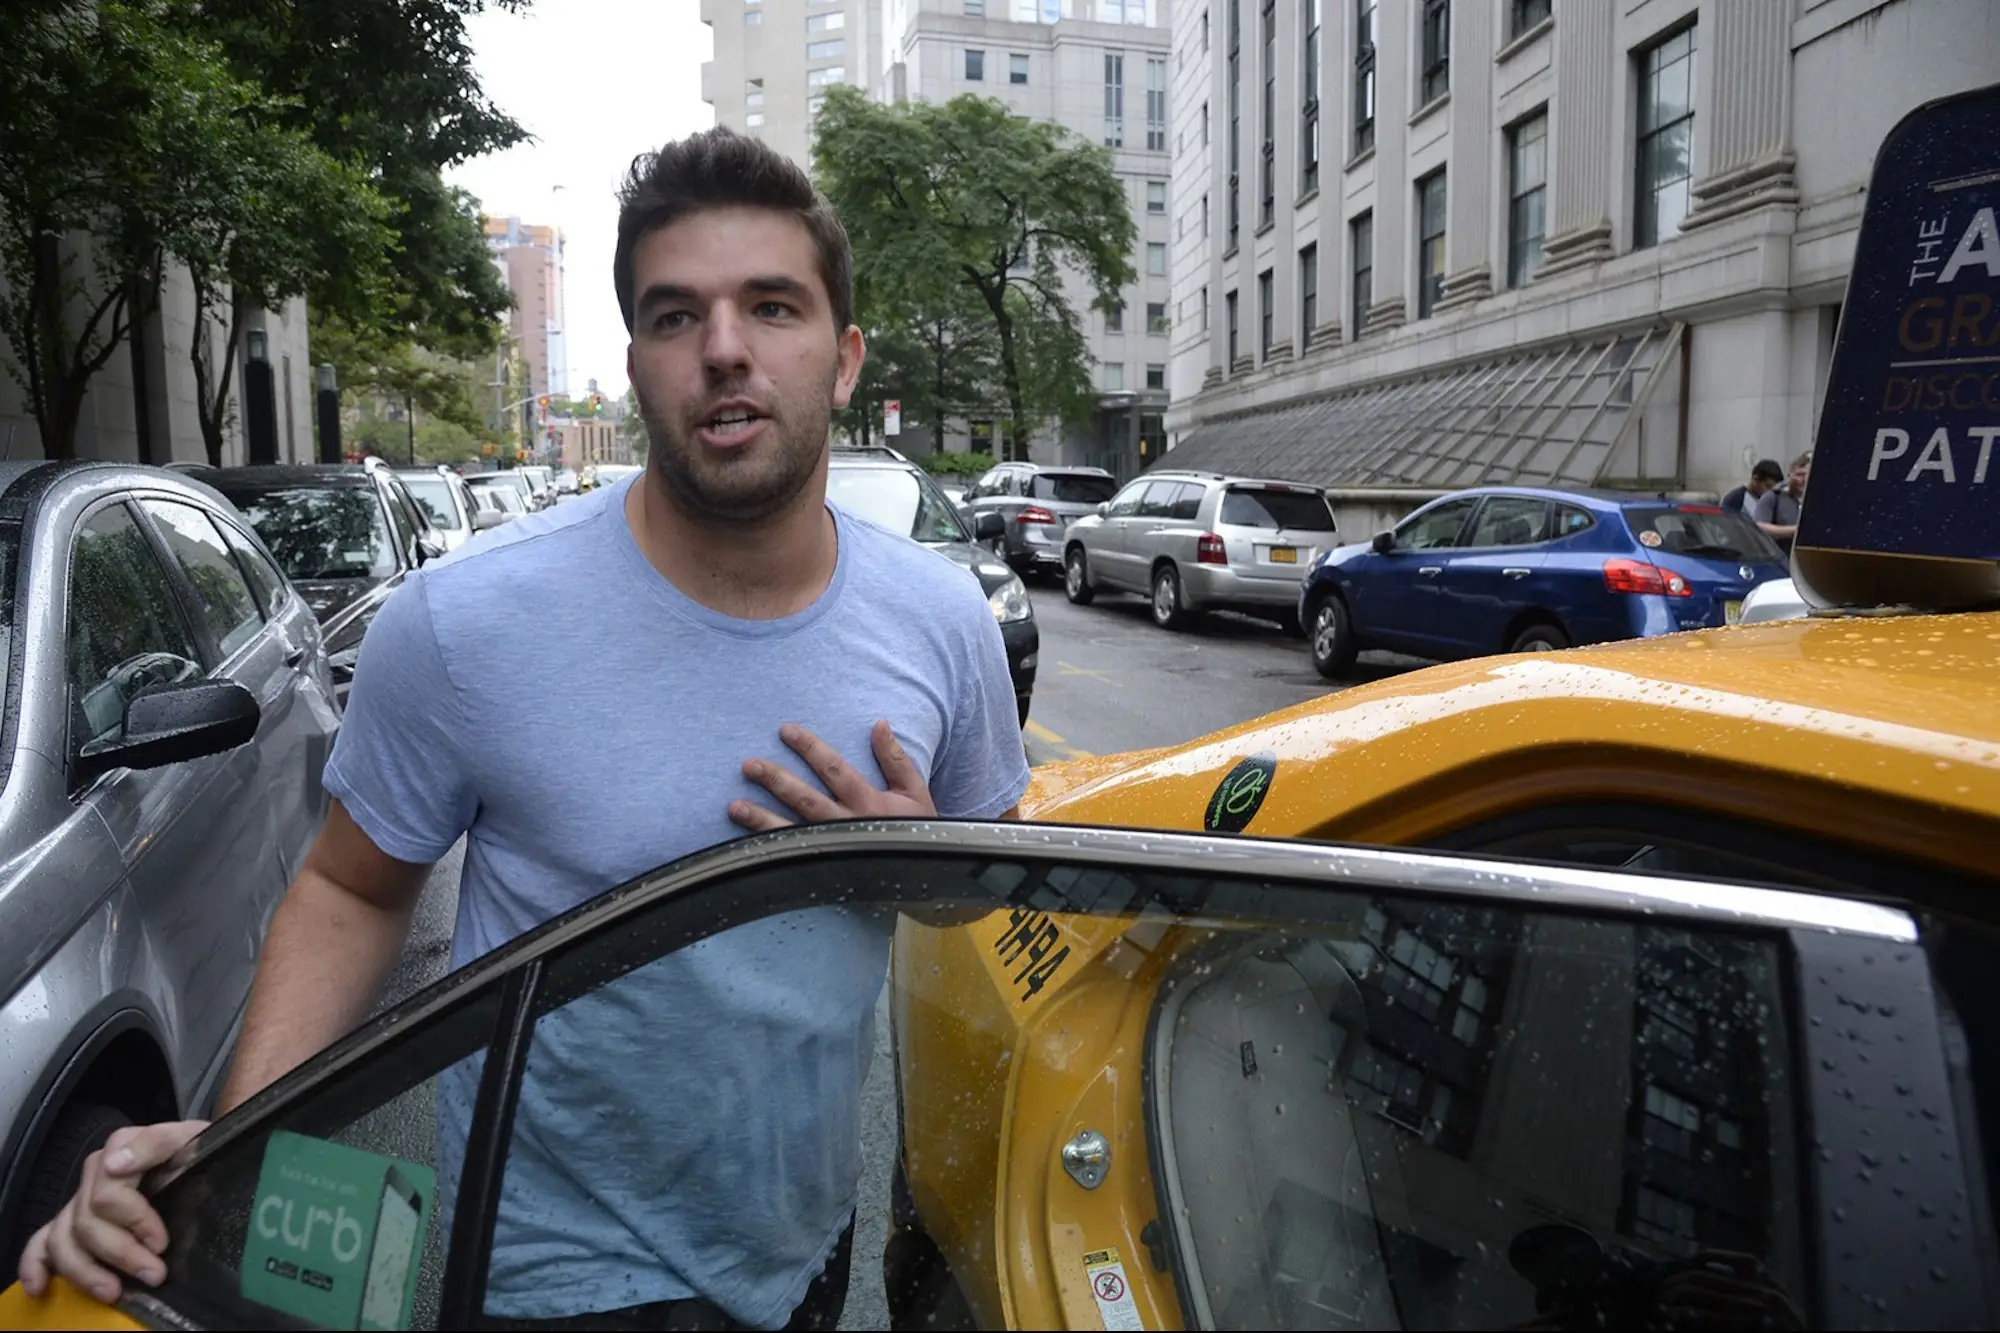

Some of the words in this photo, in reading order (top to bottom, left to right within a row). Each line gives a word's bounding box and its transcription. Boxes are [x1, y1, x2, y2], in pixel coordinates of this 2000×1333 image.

[1908, 216, 1948, 287] THE
[1866, 426, 2000, 484] PAT
[256, 1194, 363, 1263] curb
